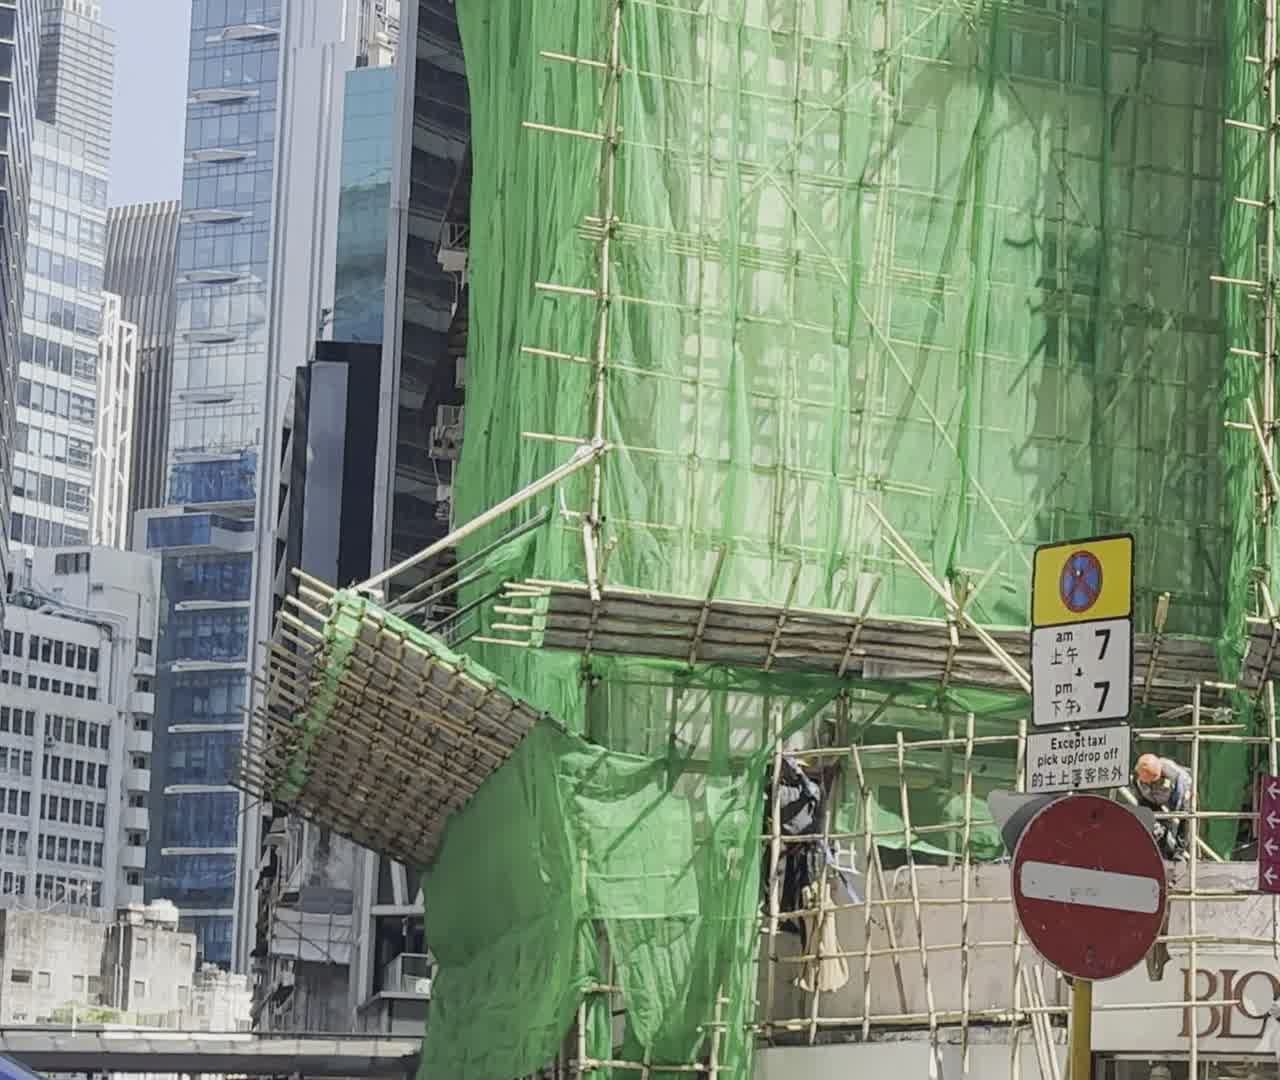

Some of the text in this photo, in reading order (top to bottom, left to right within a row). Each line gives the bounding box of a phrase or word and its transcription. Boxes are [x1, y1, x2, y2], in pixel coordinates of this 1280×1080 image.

[1056, 629, 1111, 660] am 7
[1051, 647, 1079, 665] 上午
[1055, 681, 1110, 713] pm 7
[1051, 699, 1081, 718] 下午
[1051, 735, 1107, 754] Except taxi
[1038, 748, 1119, 769] pick up/drop off
